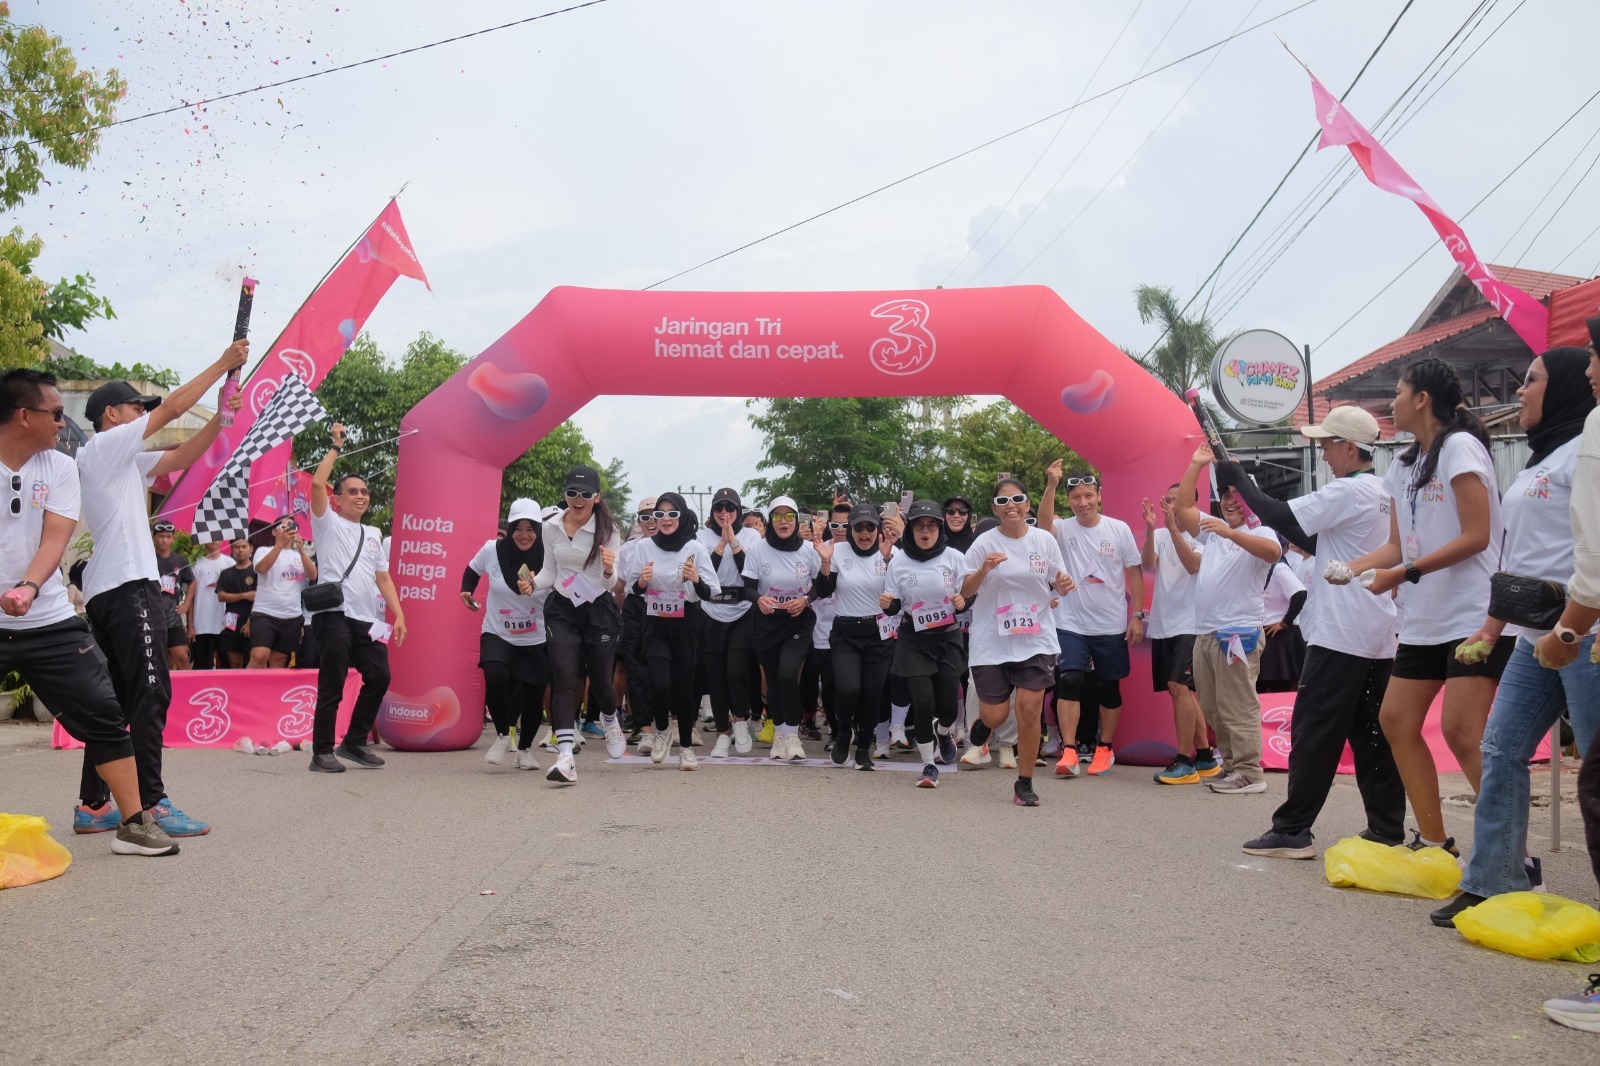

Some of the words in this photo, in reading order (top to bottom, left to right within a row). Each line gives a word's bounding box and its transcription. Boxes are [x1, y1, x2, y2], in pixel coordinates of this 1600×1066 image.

[654, 316, 749, 339] Jaringan
[755, 318, 782, 336] Tri
[655, 339, 724, 358] hemat
[729, 340, 770, 359] dan
[776, 341, 844, 362] cepat.
[1245, 360, 1299, 382] CHANEZ
[402, 513, 454, 533] Kuota
[400, 540, 447, 558] puas,
[397, 558, 447, 582] harga
[400, 584, 437, 601] pas!
[652, 602, 678, 612] 0151
[504, 620, 532, 629] 0166
[917, 610, 948, 625] 0095
[1003, 617, 1034, 629] 0123
[140, 609, 156, 684] JAGUAR
[389, 704, 429, 718] indosat
